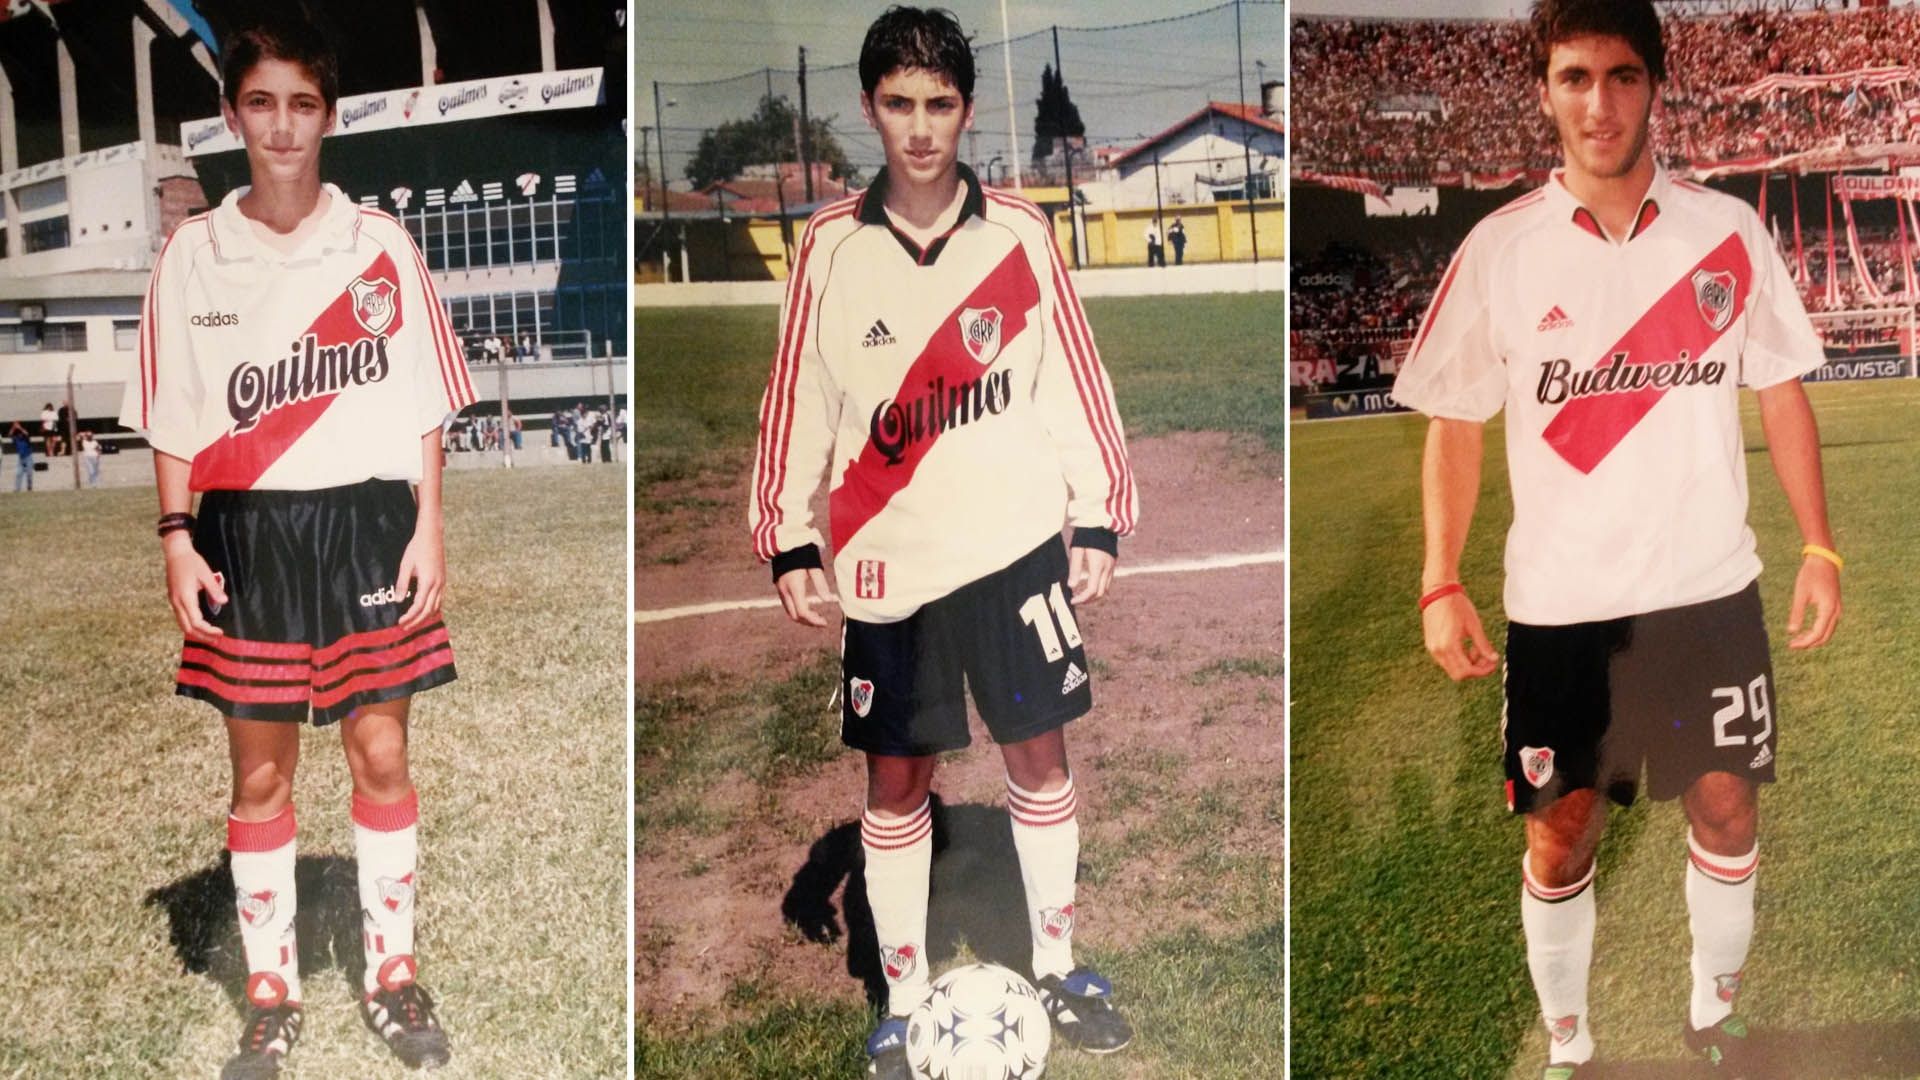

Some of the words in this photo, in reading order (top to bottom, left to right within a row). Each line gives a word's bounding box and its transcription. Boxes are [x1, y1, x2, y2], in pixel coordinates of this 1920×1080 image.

[342, 97, 388, 128] Quilmes
[438, 84, 488, 116] Quilmes
[541, 72, 595, 104] Quilmes
[190, 311, 240, 327] adidas
[862, 336, 897, 348] adidas
[227, 335, 390, 433] Quilmes
[1536, 351, 1727, 405] Budweiser
[870, 368, 1014, 468] Quilmes
[1018, 581, 1083, 663] 11
[1711, 673, 1772, 747] 29
